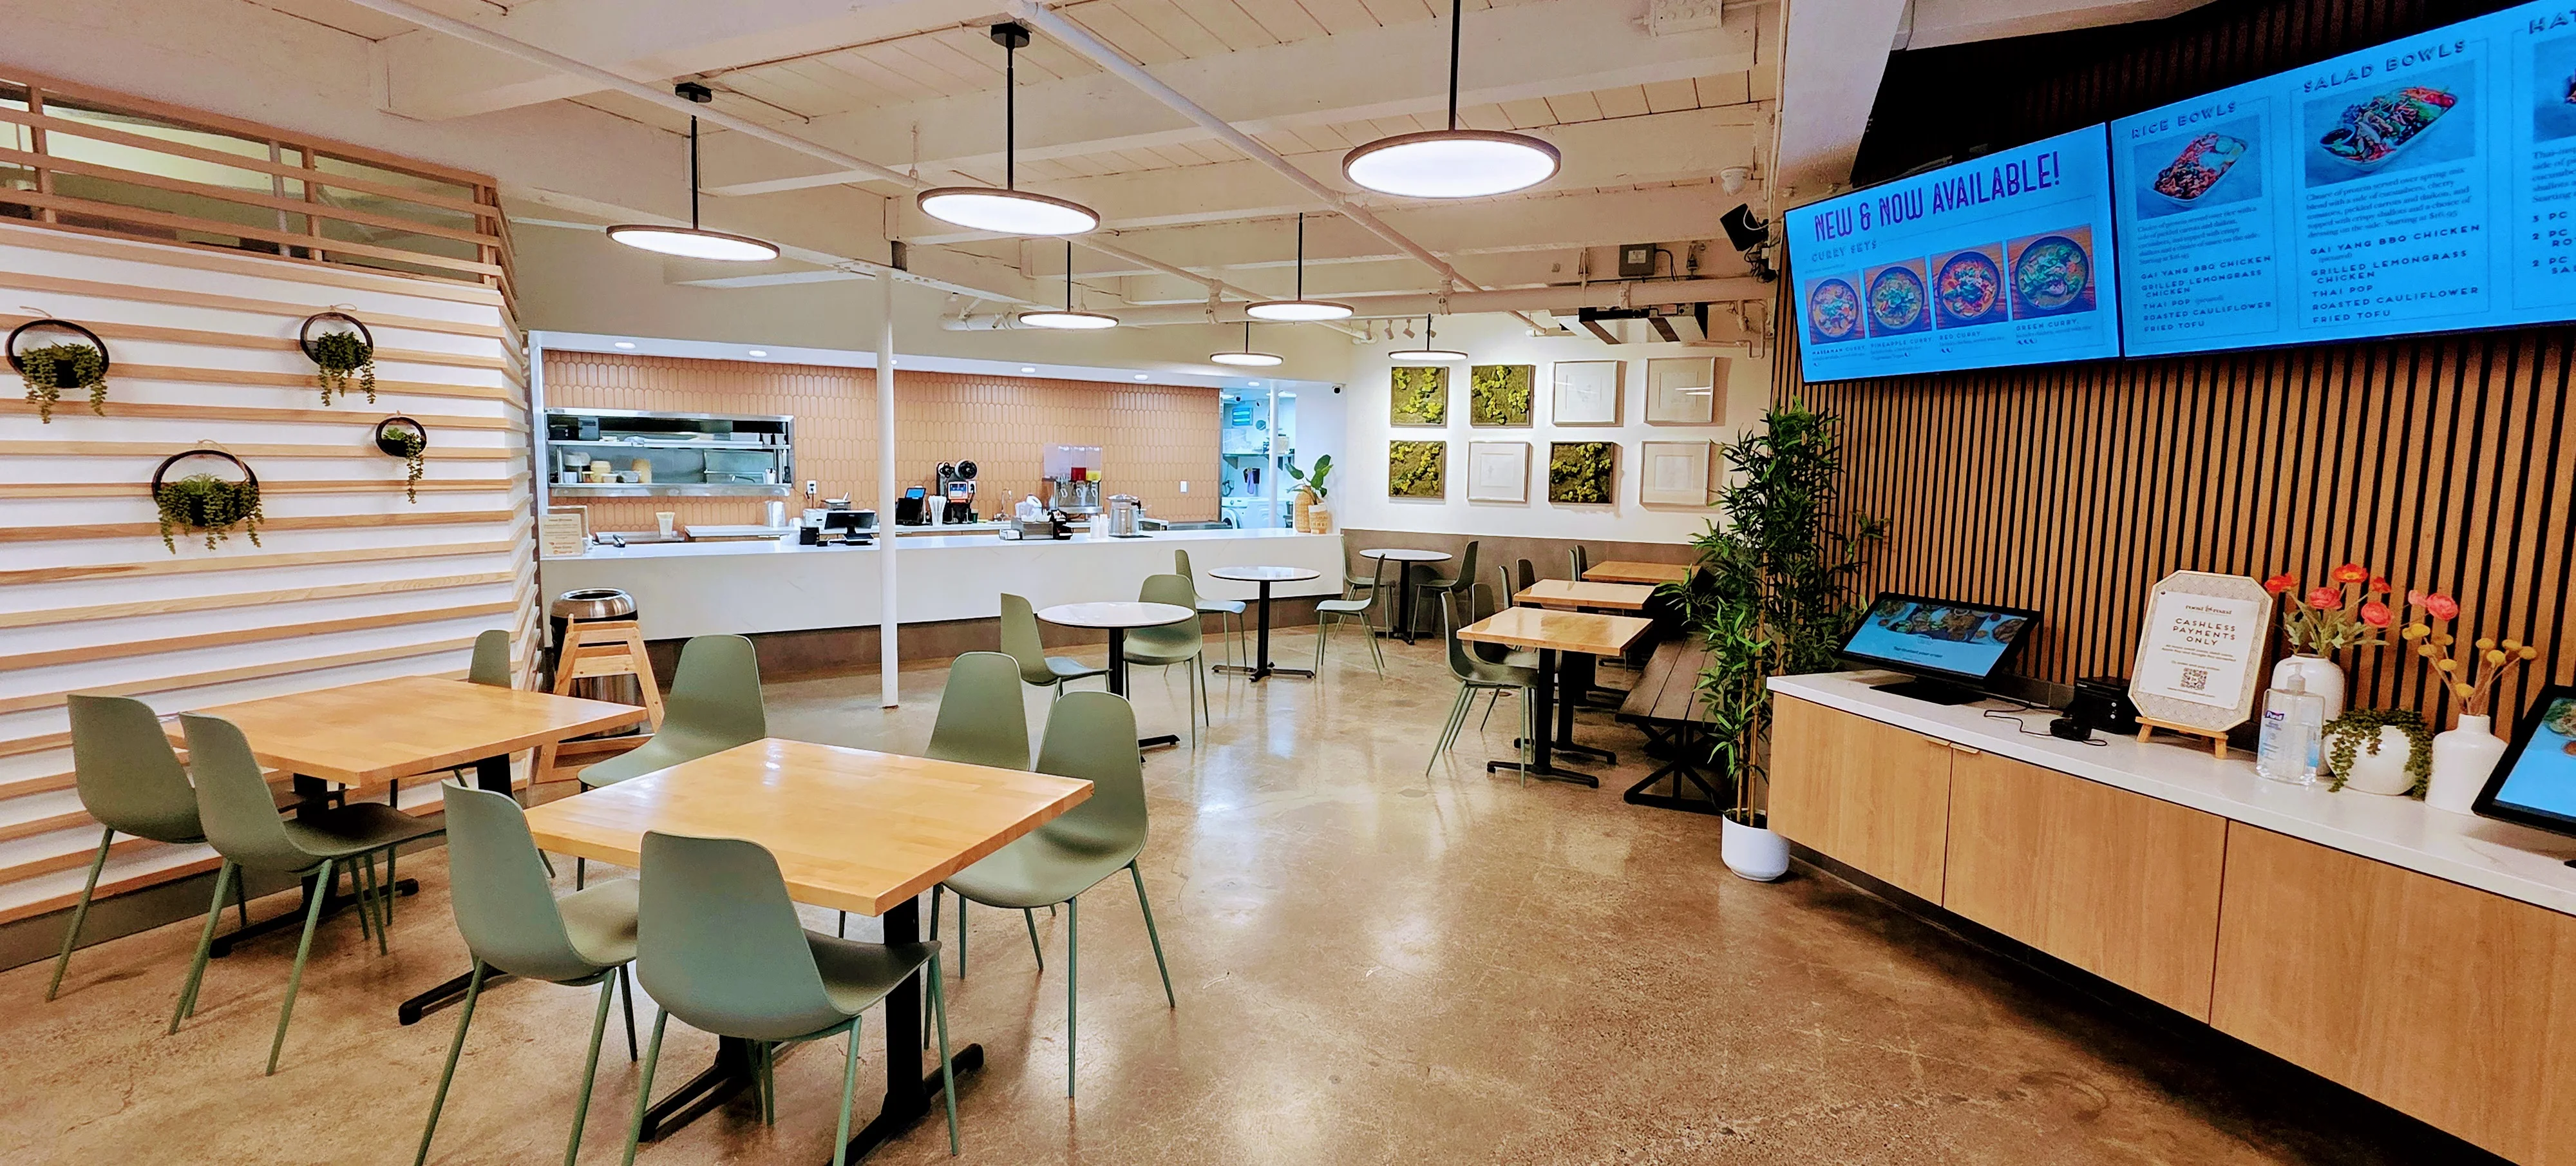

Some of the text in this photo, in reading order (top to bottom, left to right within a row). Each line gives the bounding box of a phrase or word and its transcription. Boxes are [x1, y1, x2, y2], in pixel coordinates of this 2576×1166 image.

[2304, 39, 2465, 93] SALAD BOWLS
[2132, 101, 2236, 139] RICE BOWLS
[1814, 151, 2060, 242] NEW & NOW AVAILABLE!
[2532, 211, 2568, 223] 3 PC
[2310, 247, 2331, 255] GAI
[2337, 240, 2372, 251] YANG
[2413, 224, 2480, 240] CHICKEN
[2548, 229, 2568, 238] PC
[2552, 237, 2576, 247] RO
[1812, 239, 1877, 262] CURRY SETS
[2161, 267, 2188, 276] YANG
[2193, 263, 2215, 272] BBQ
[2220, 255, 2271, 268] CHICKEN
[2311, 250, 2467, 276] GRILLED LEMONGRASS
[2532, 256, 2568, 267] 2 PC
[2141, 269, 2262, 291] GRILLED LEMONGRASS
[2316, 271, 2375, 283] CHICKEN
[2145, 287, 2190, 298] CHICKEN
[2311, 285, 2373, 297] THAI POP
[2312, 287, 2478, 311] ROASTED CAULIFLOWER
[2143, 301, 2271, 321] ROASTED CAULIFLOWER
[2313, 310, 2391, 323] FRIED TOFU
[2016, 323, 2044, 331] GREEN
[2179, 320, 2205, 329] TOFU
[1870, 340, 1906, 349] PINEAPPLE
[2175, 618, 2235, 632] CASHLESS
[2173, 626, 2235, 640] PAYMENTS
[2186, 636, 2217, 645] ONLY
